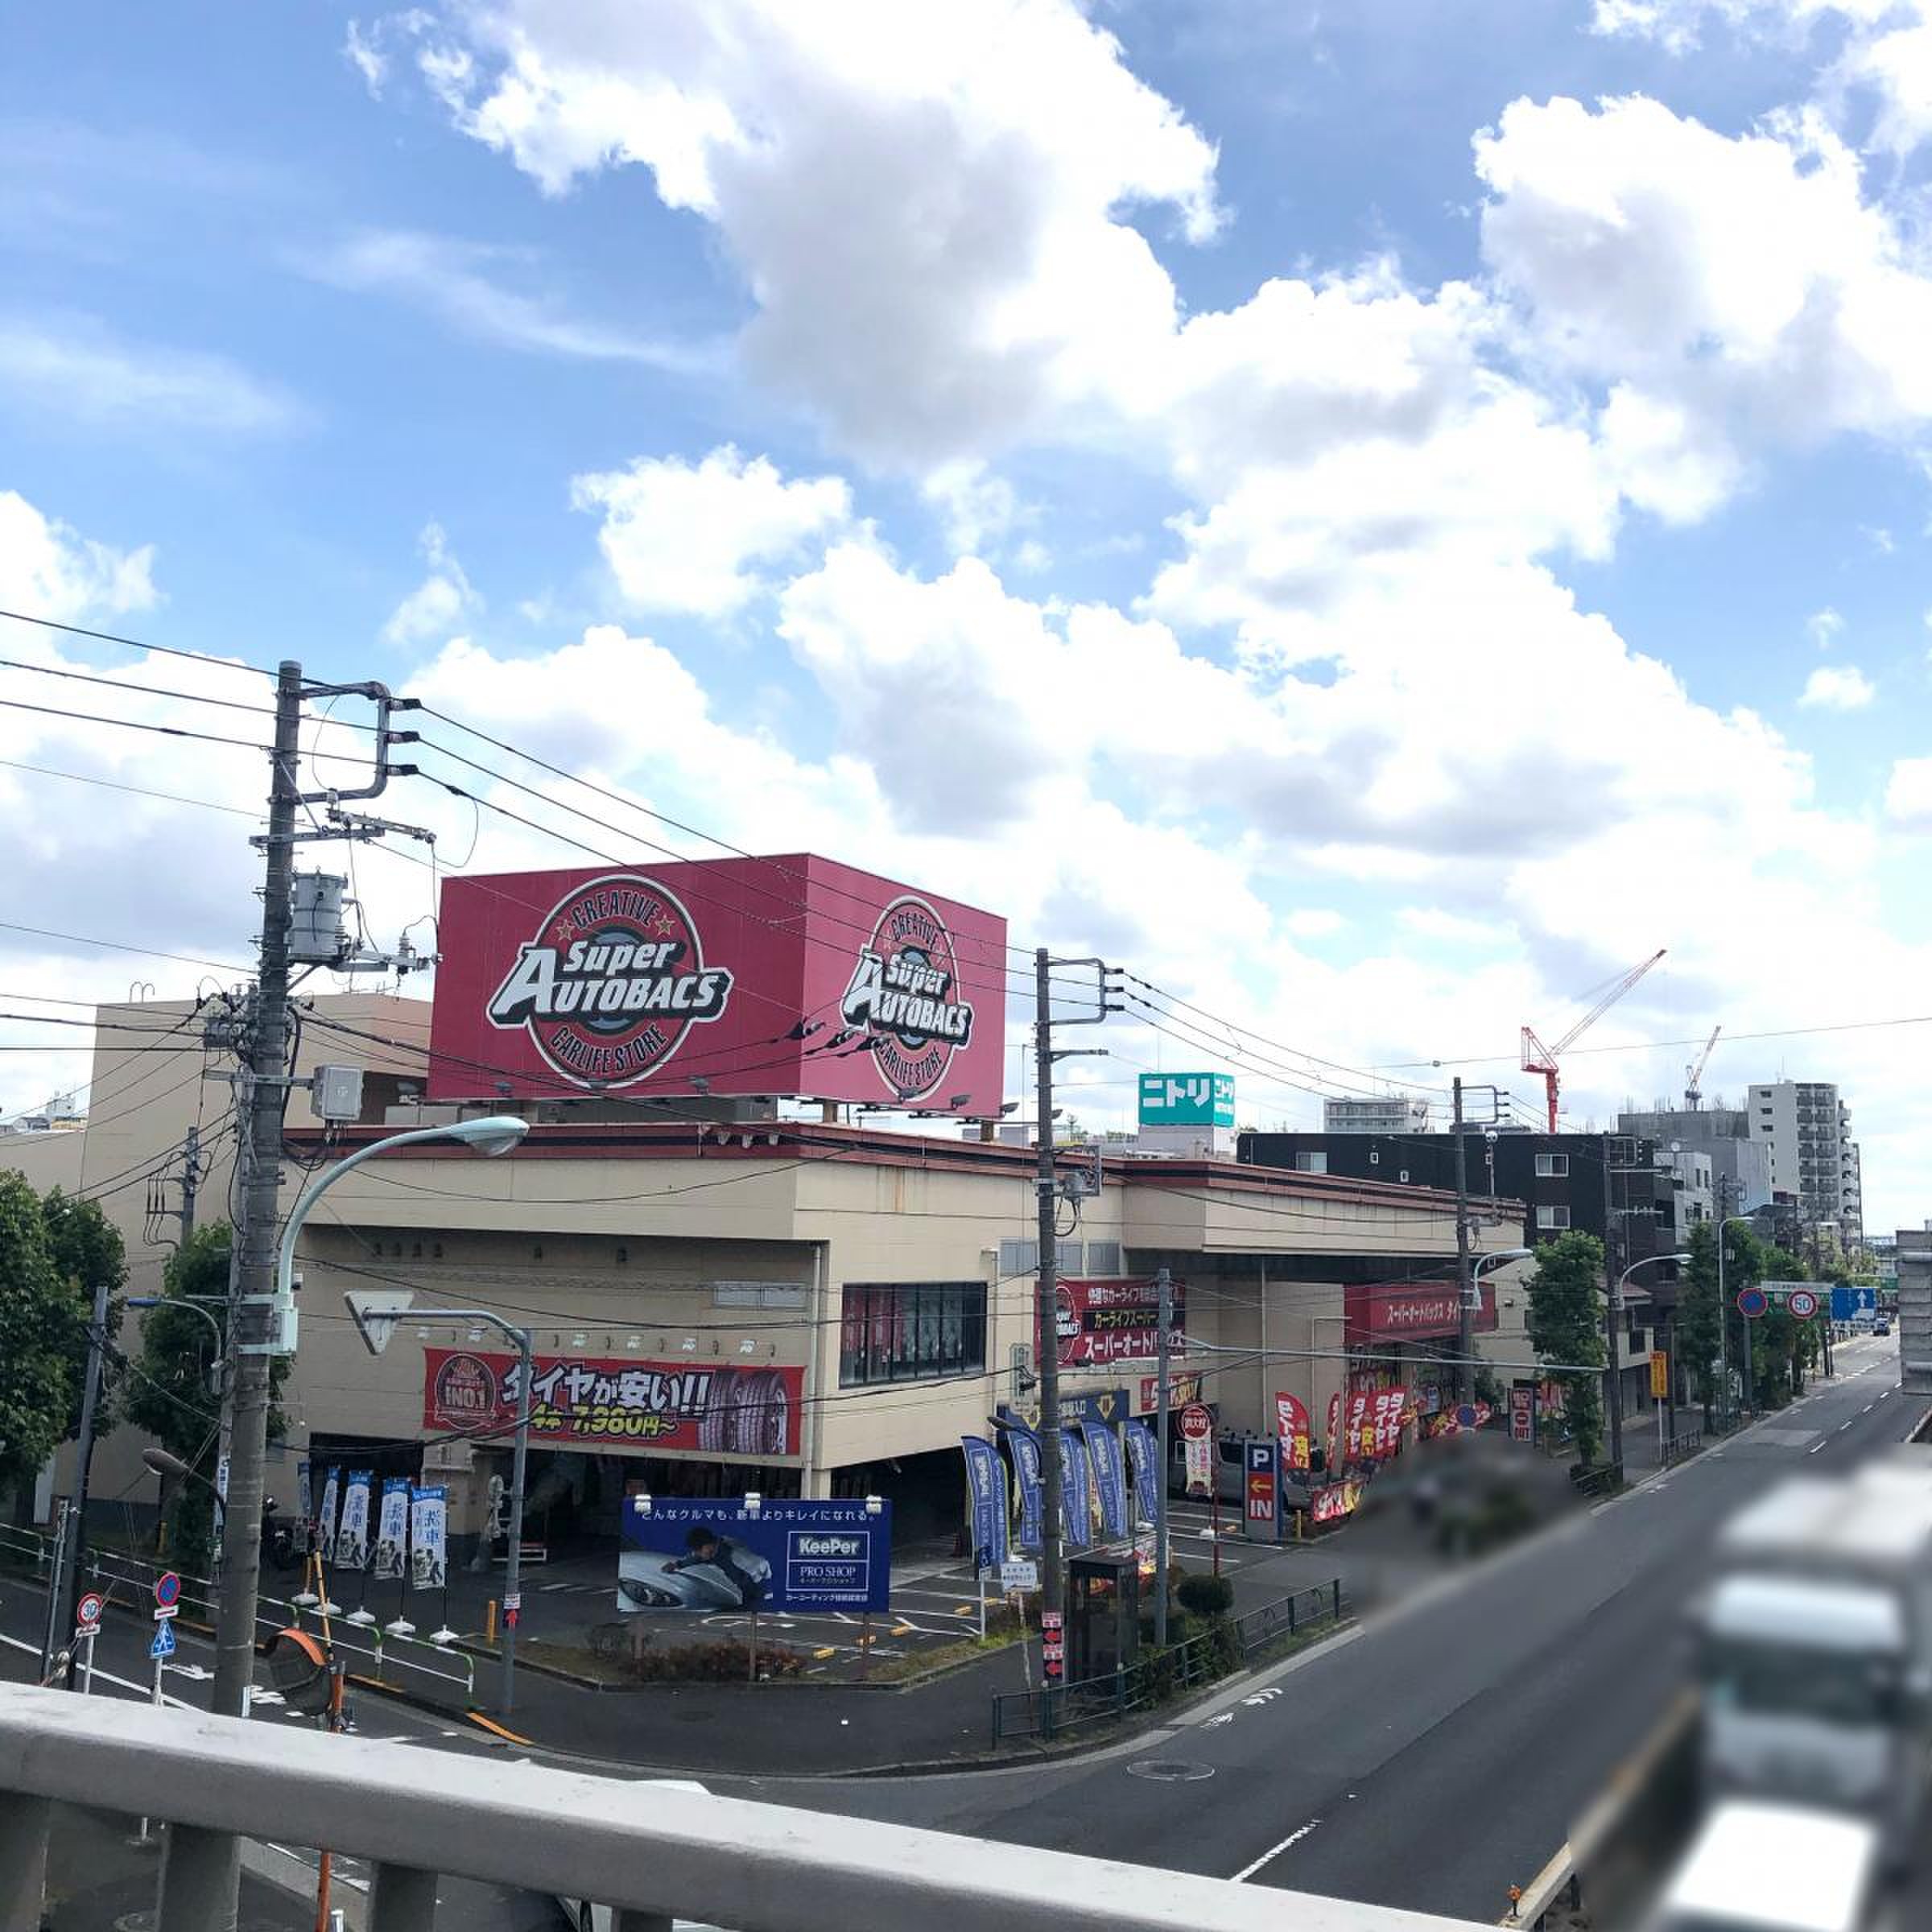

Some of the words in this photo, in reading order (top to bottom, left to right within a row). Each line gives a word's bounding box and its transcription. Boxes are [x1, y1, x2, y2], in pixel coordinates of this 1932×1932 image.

[571, 889, 659, 930] CREATIVE
[891, 912, 939, 951] CREATIVE
[563, 941, 676, 976] Super
[886, 954, 948, 996] Super
[1142, 1079, 1211, 1108] ニトリ
[1794, 1297, 1810, 1311] 50
[1253, 1449, 1269, 1468] P
[1249, 1500, 1273, 1518] IN
[799, 1537, 861, 1555] KeePer
[800, 1566, 824, 1577] PRO
[825, 1566, 857, 1577] SHOP
[83, 1602, 97, 1620] 30
